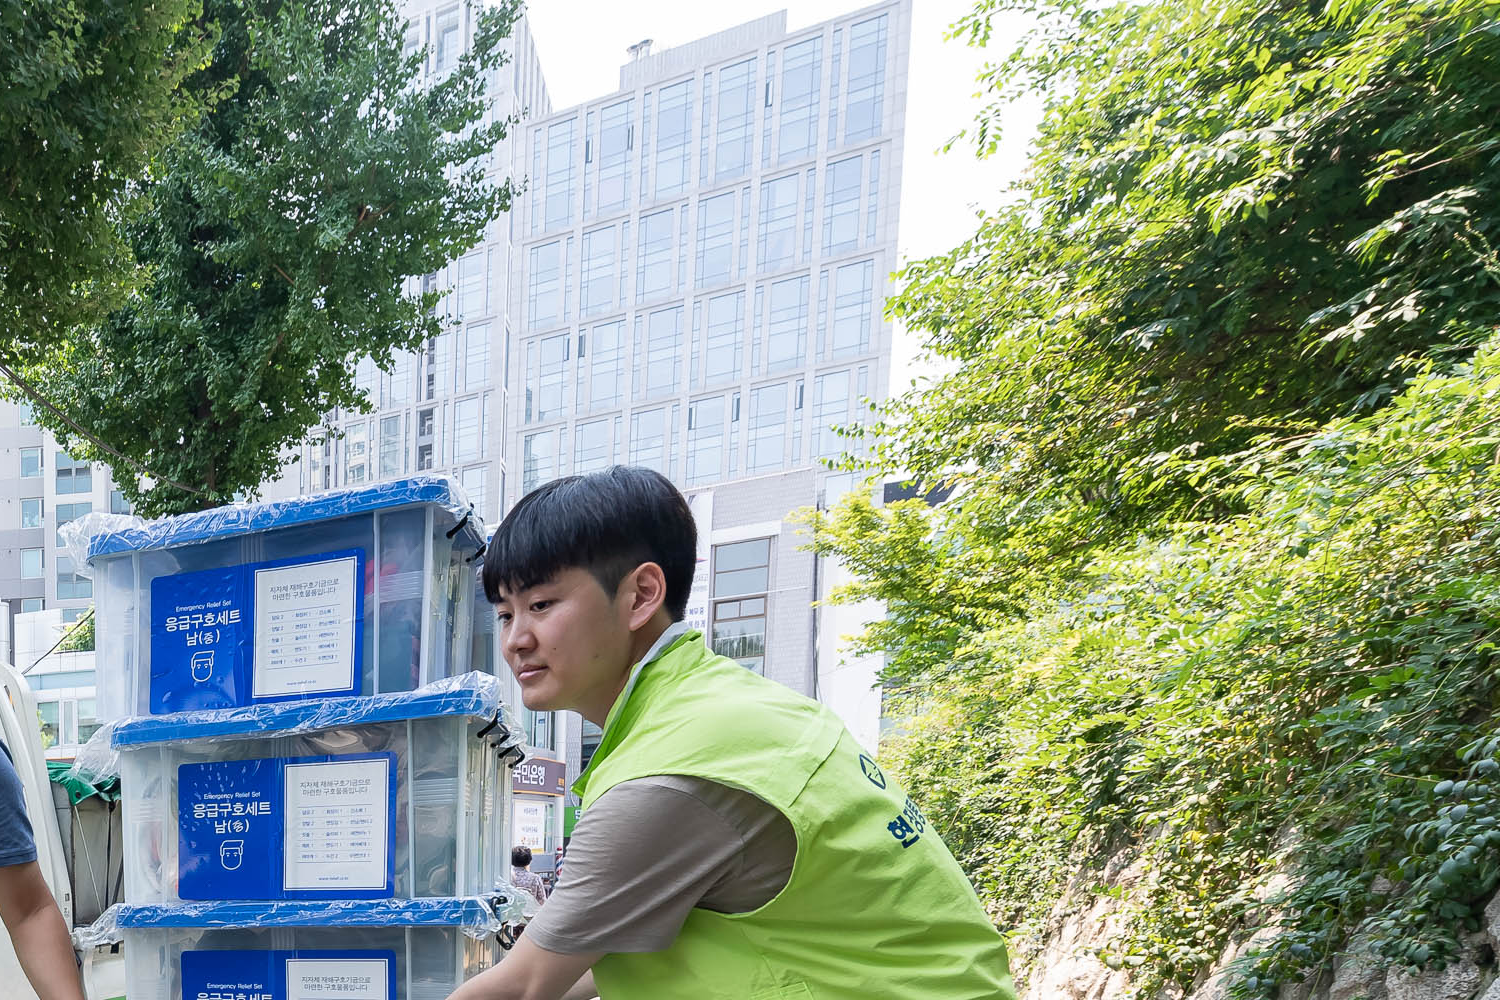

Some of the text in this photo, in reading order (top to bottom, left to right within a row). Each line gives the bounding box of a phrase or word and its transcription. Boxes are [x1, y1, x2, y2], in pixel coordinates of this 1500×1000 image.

[175, 604, 205, 613] Emergency
[206, 601, 221, 609] Relief
[165, 609, 241, 632] 응급구호세트
[186, 629, 220, 646] 남(중)
[193, 801, 271, 818] 응급구호세트
[214, 818, 250, 834] 남(중)
